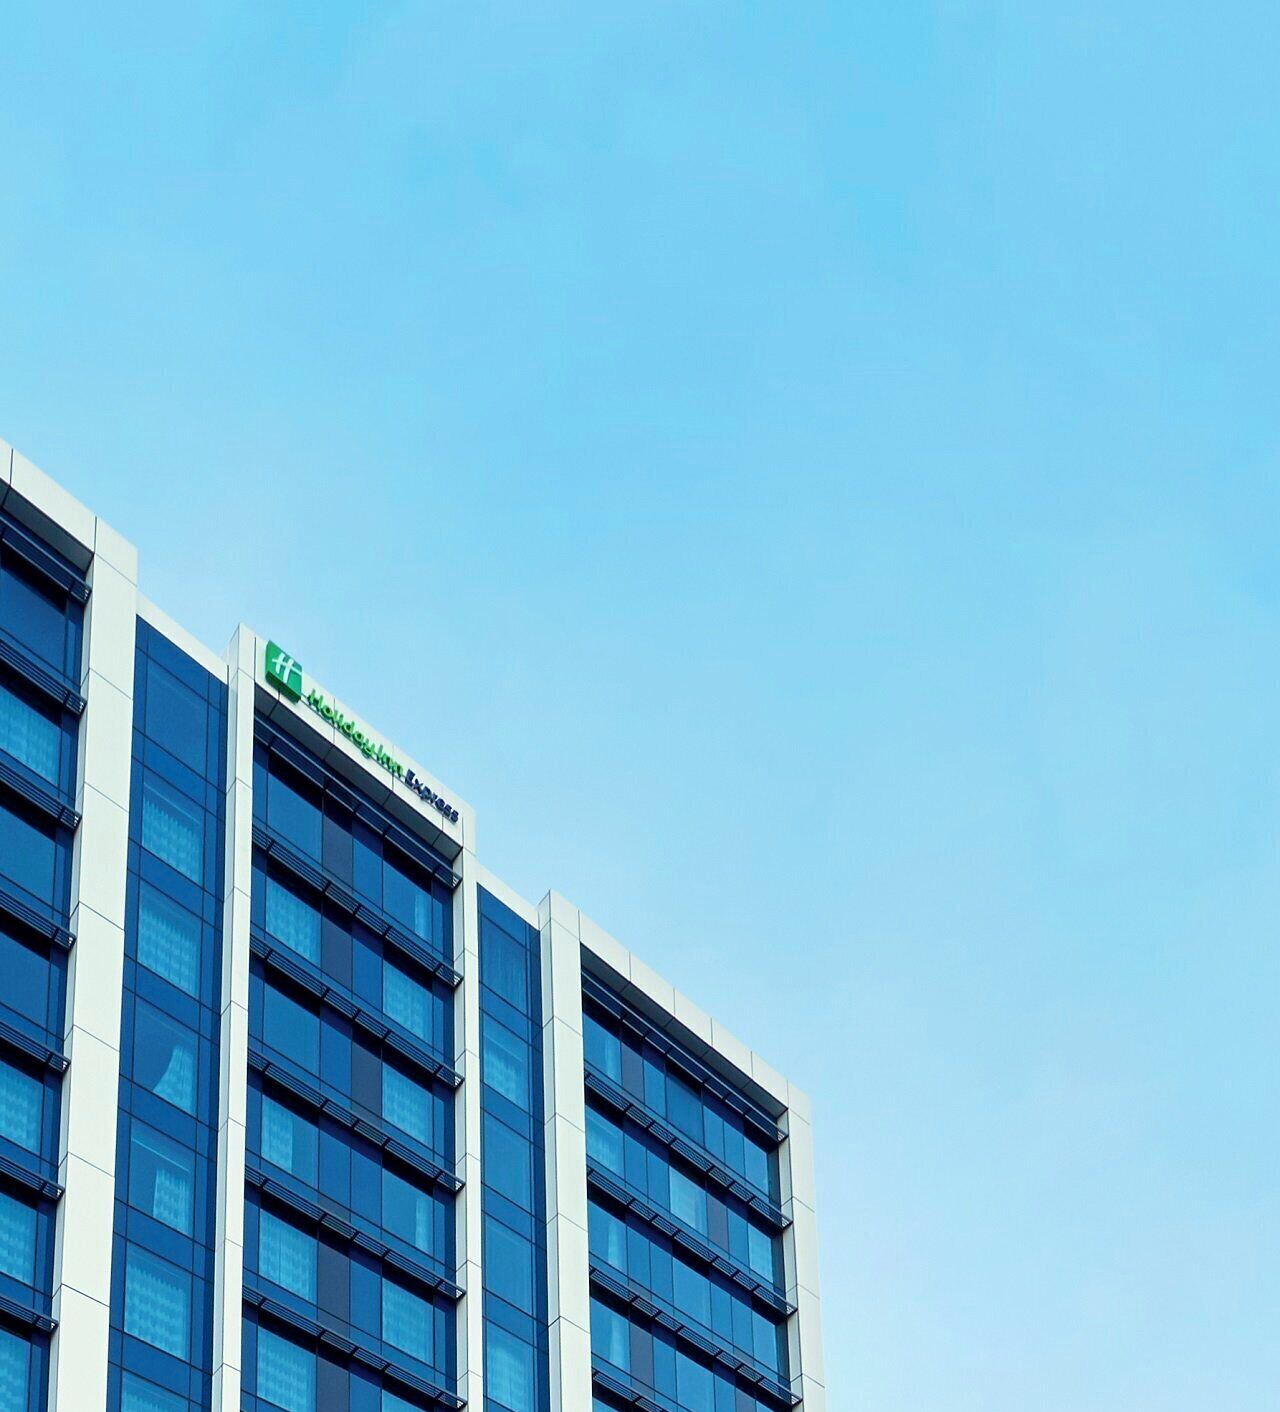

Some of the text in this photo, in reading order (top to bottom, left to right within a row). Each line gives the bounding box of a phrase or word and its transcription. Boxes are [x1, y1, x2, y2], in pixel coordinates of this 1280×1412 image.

[308, 688, 460, 824] Holiday Inn Express
